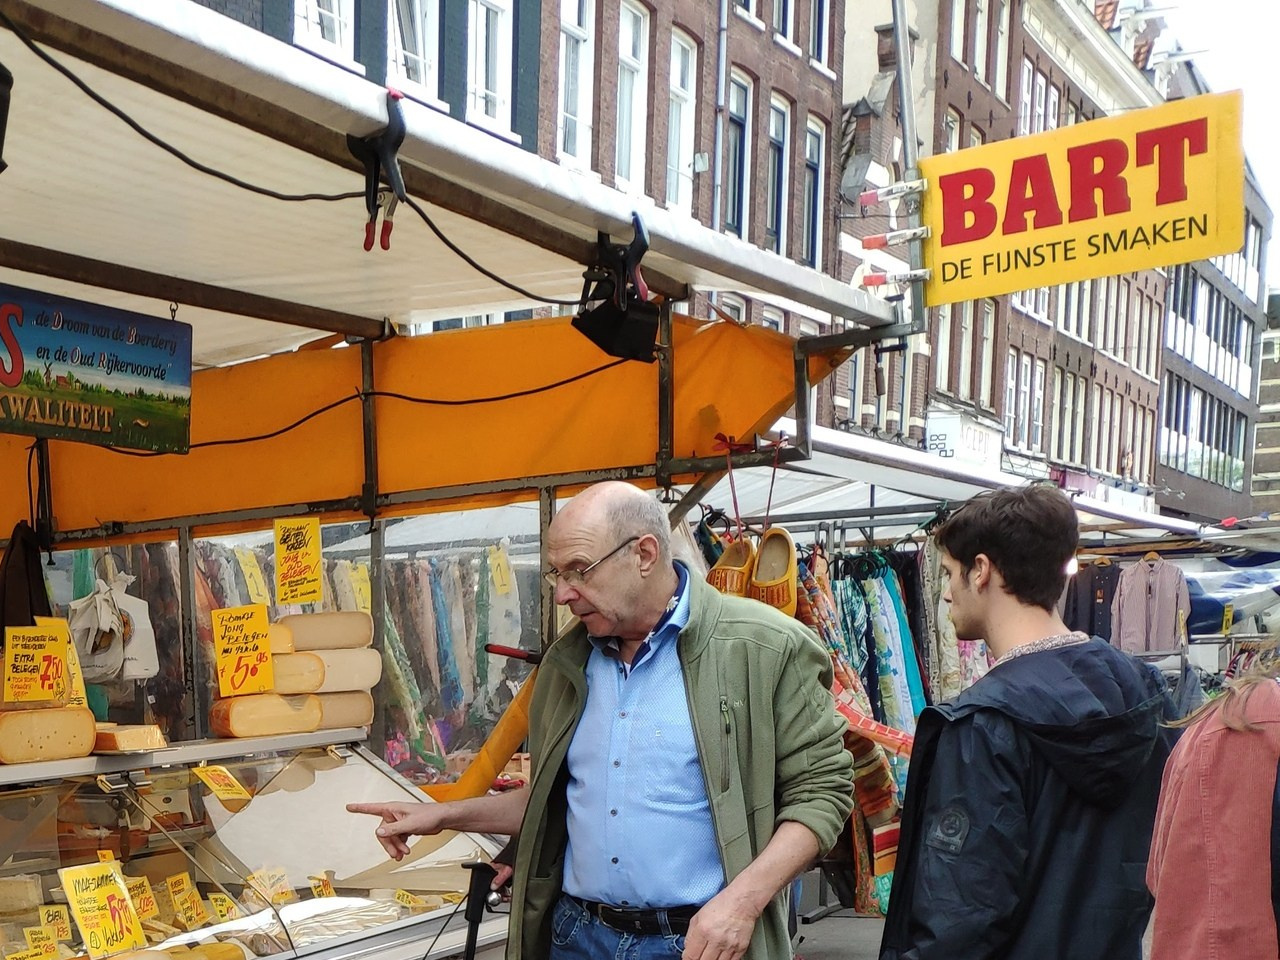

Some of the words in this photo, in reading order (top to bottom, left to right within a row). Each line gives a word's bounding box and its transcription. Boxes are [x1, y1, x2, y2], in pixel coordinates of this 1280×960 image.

[939, 117, 1208, 247] BART
[941, 257, 972, 282] DE
[982, 238, 1076, 276] FIJNSTE
[1087, 213, 1208, 257] SMAKEN
[36, 346, 50, 360] en
[54, 345, 68, 363] de
[70, 346, 95, 367] Oud
[51, 311, 90, 336] Droom
[92, 326, 110, 339] van
[112, 327, 125, 342] de
[126, 325, 177, 356] Boerderij
[11, 662, 41, 674] BELEGEN
